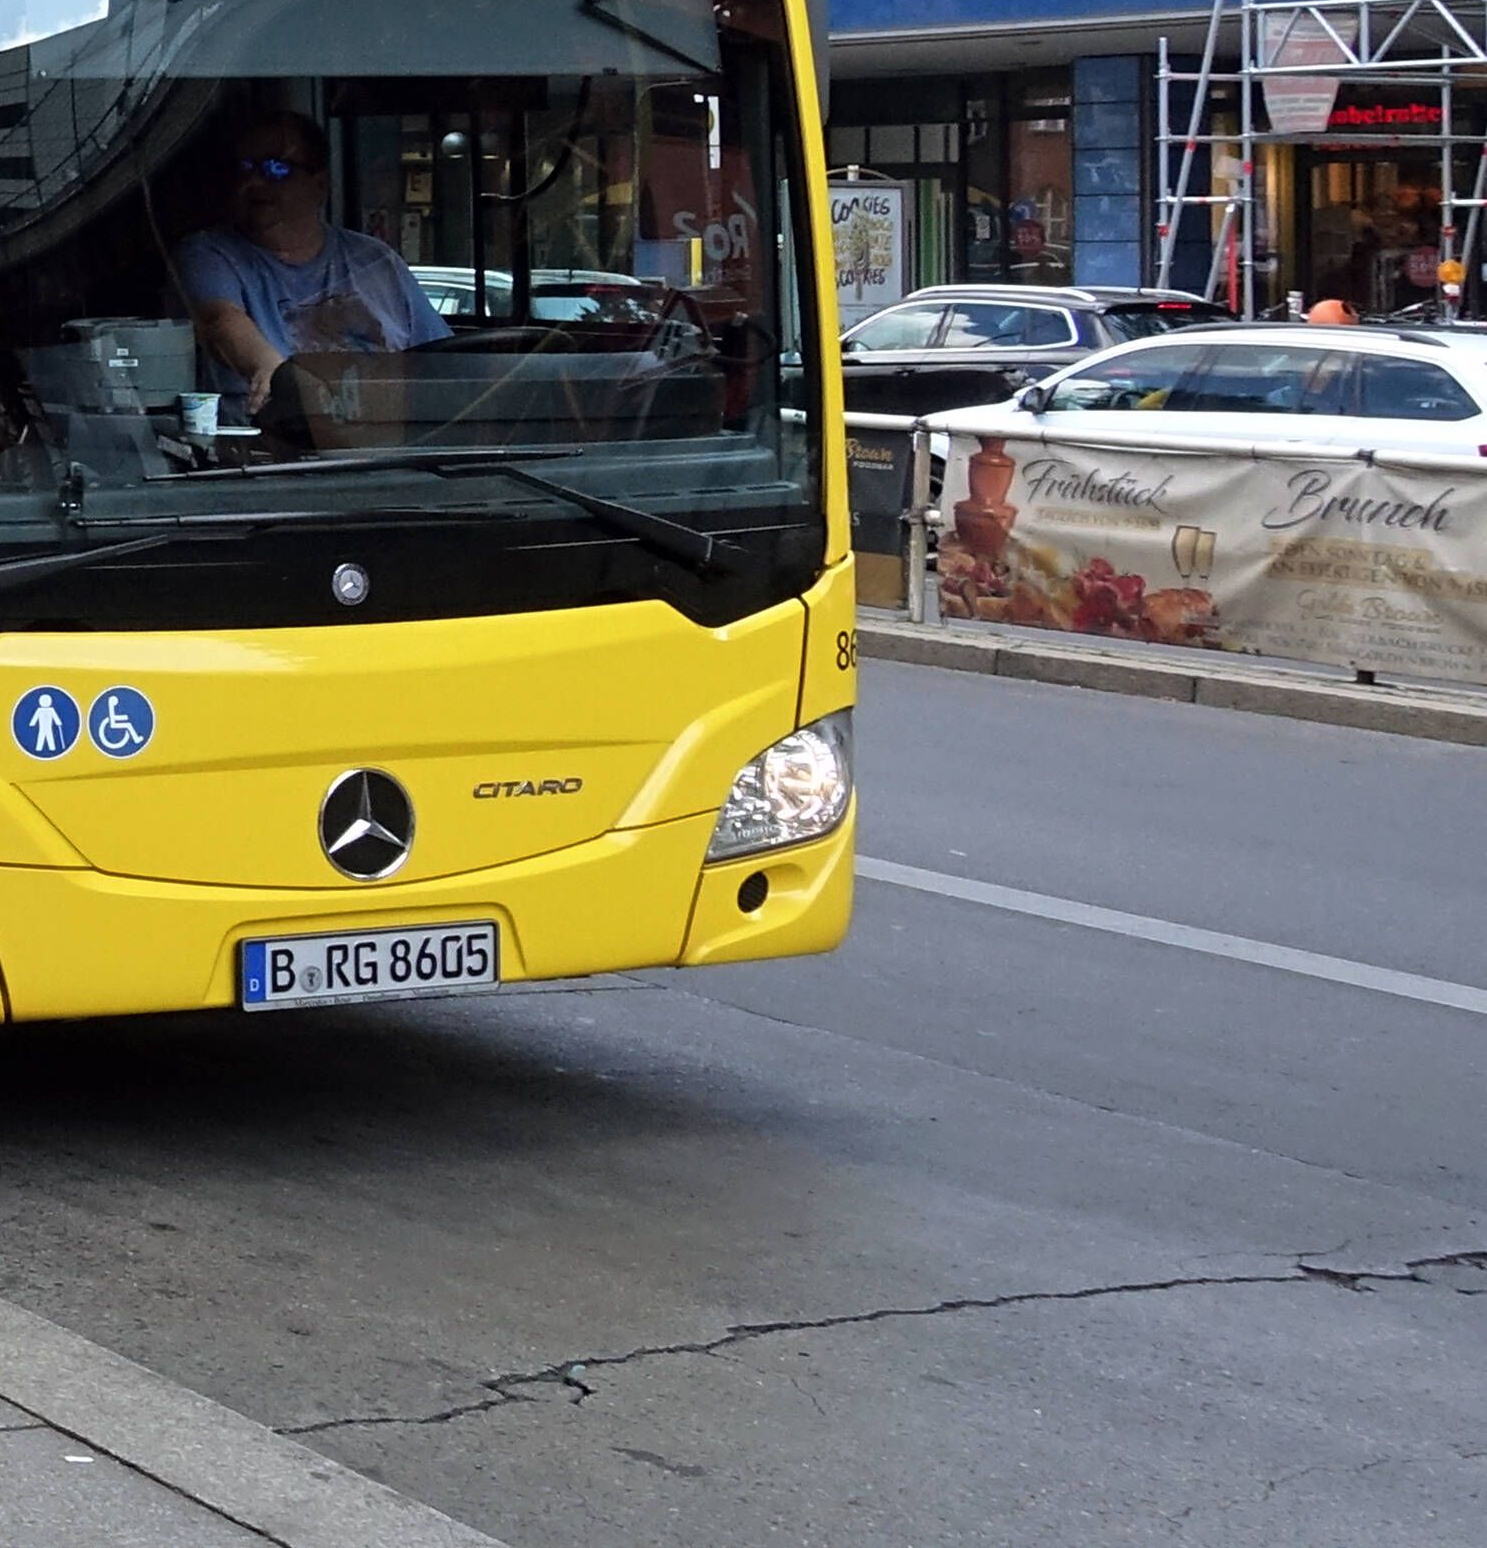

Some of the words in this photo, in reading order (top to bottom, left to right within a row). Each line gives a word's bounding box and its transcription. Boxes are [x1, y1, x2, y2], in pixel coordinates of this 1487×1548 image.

[1022, 459, 1165, 515] Frühstück
[1262, 469, 1455, 531] Brunch
[473, 778, 583, 799] CITARO
[249, 979, 260, 992] D
[271, 949, 295, 993] B
[326, 942, 378, 989] RG
[390, 933, 488, 982] 8605
